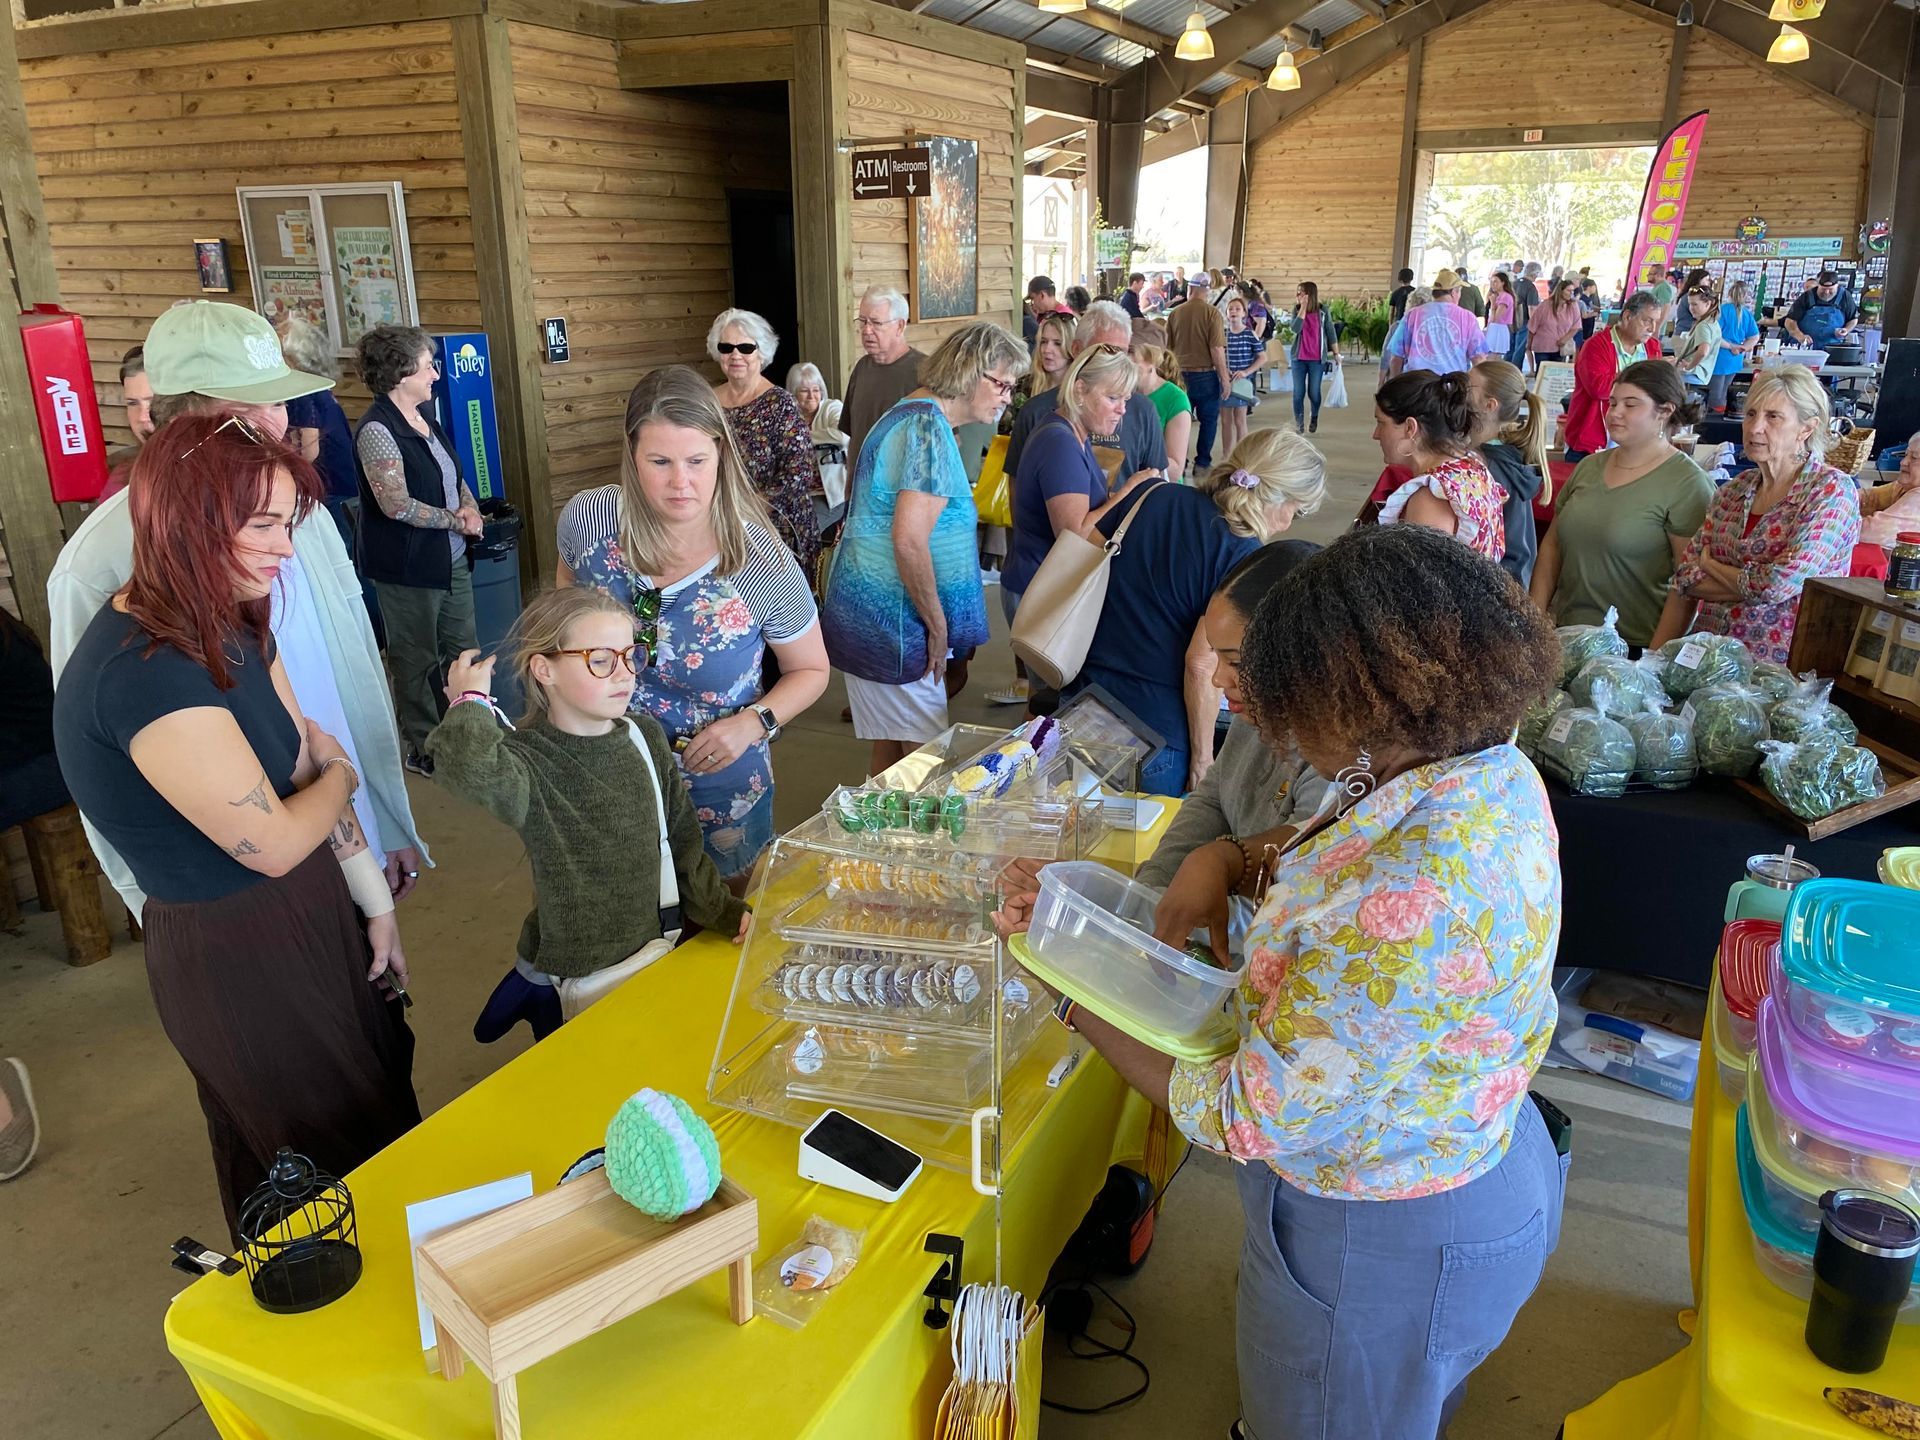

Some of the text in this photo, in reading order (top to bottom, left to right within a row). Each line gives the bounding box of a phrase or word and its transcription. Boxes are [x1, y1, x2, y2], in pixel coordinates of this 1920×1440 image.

[855, 158, 889, 179] ATM
[892, 160, 928, 173] Restrooms
[453, 352, 485, 379] Foley
[60, 396, 81, 449] FIRE
[471, 404, 480, 435] HAND
[474, 436, 489, 494] SANITIZING
